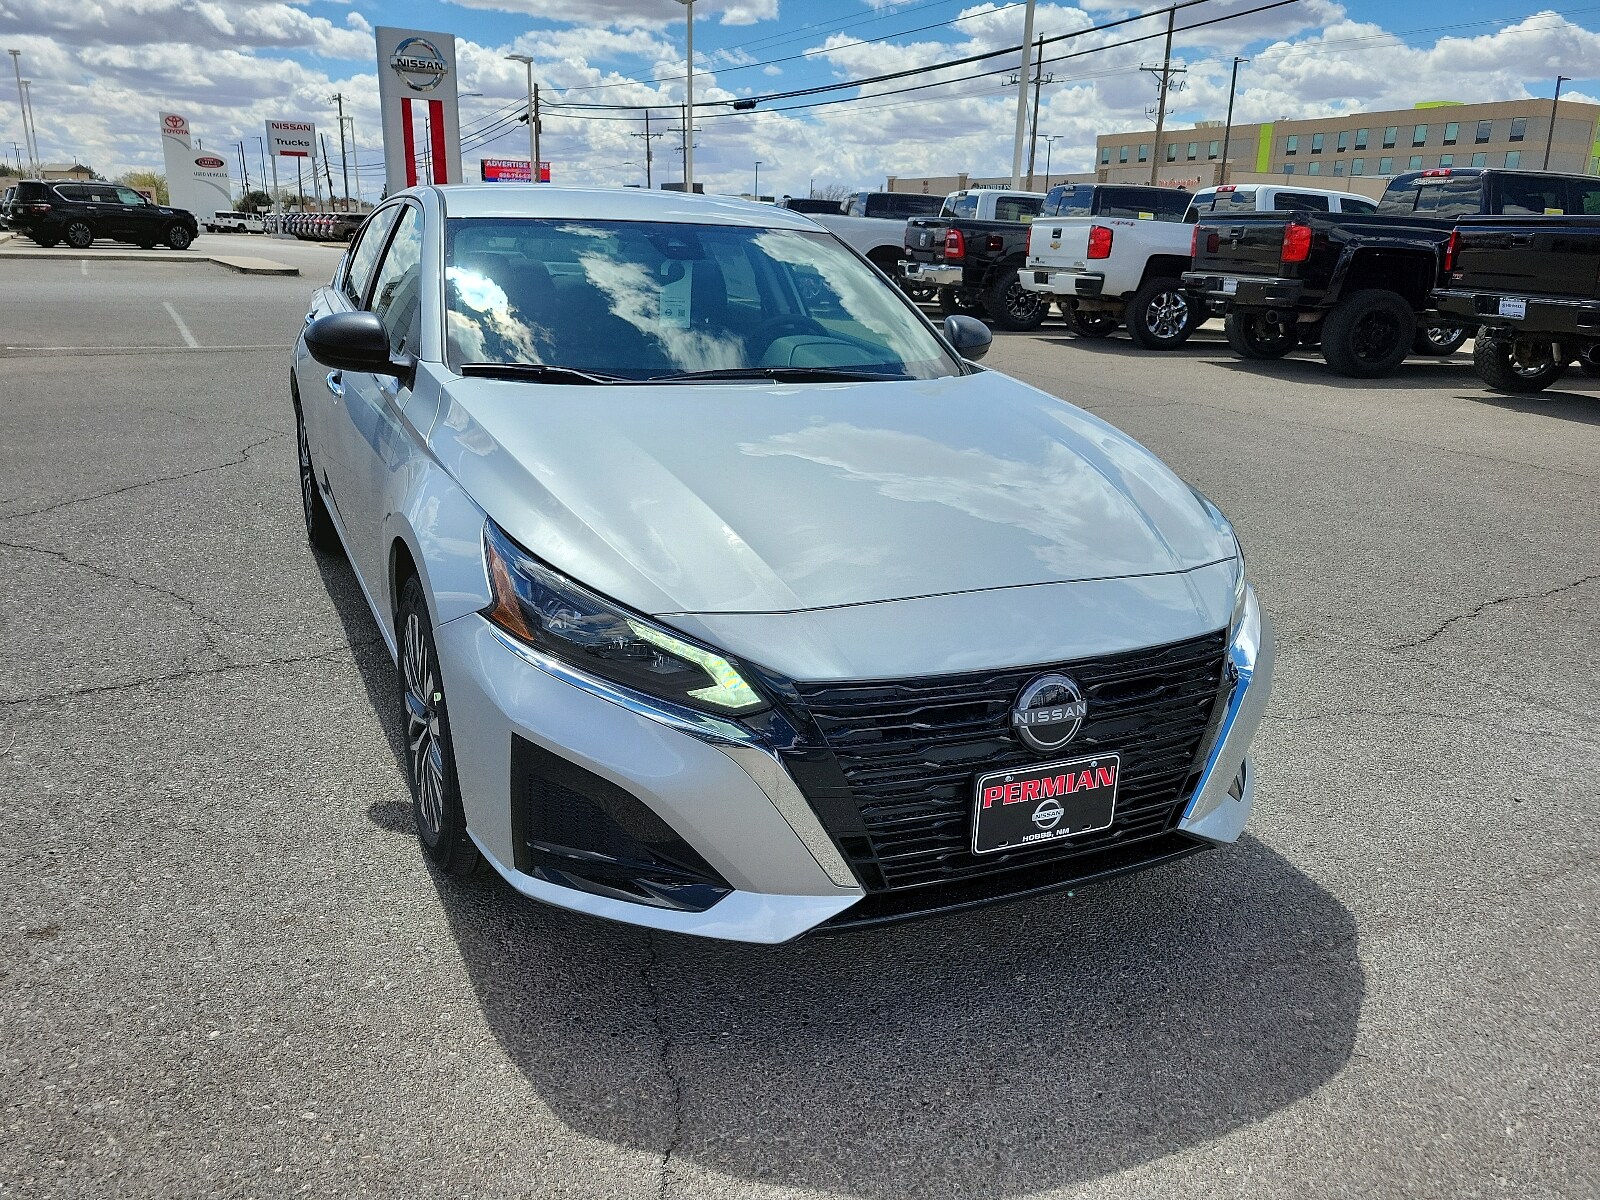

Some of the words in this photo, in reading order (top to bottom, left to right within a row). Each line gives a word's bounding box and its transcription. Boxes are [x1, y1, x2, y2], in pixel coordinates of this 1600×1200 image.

[397, 58, 443, 70] NISSAN
[271, 122, 311, 131] NISSAN
[275, 138, 310, 146] Trucks
[486, 160, 528, 168] ADVERTISE
[1014, 702, 1087, 725] NISSAN
[983, 766, 1116, 809] PERMIAN
[1034, 810, 1062, 820] NISSAN
[1022, 830, 1054, 843] HOBBS,
[1056, 827, 1070, 836] NM
